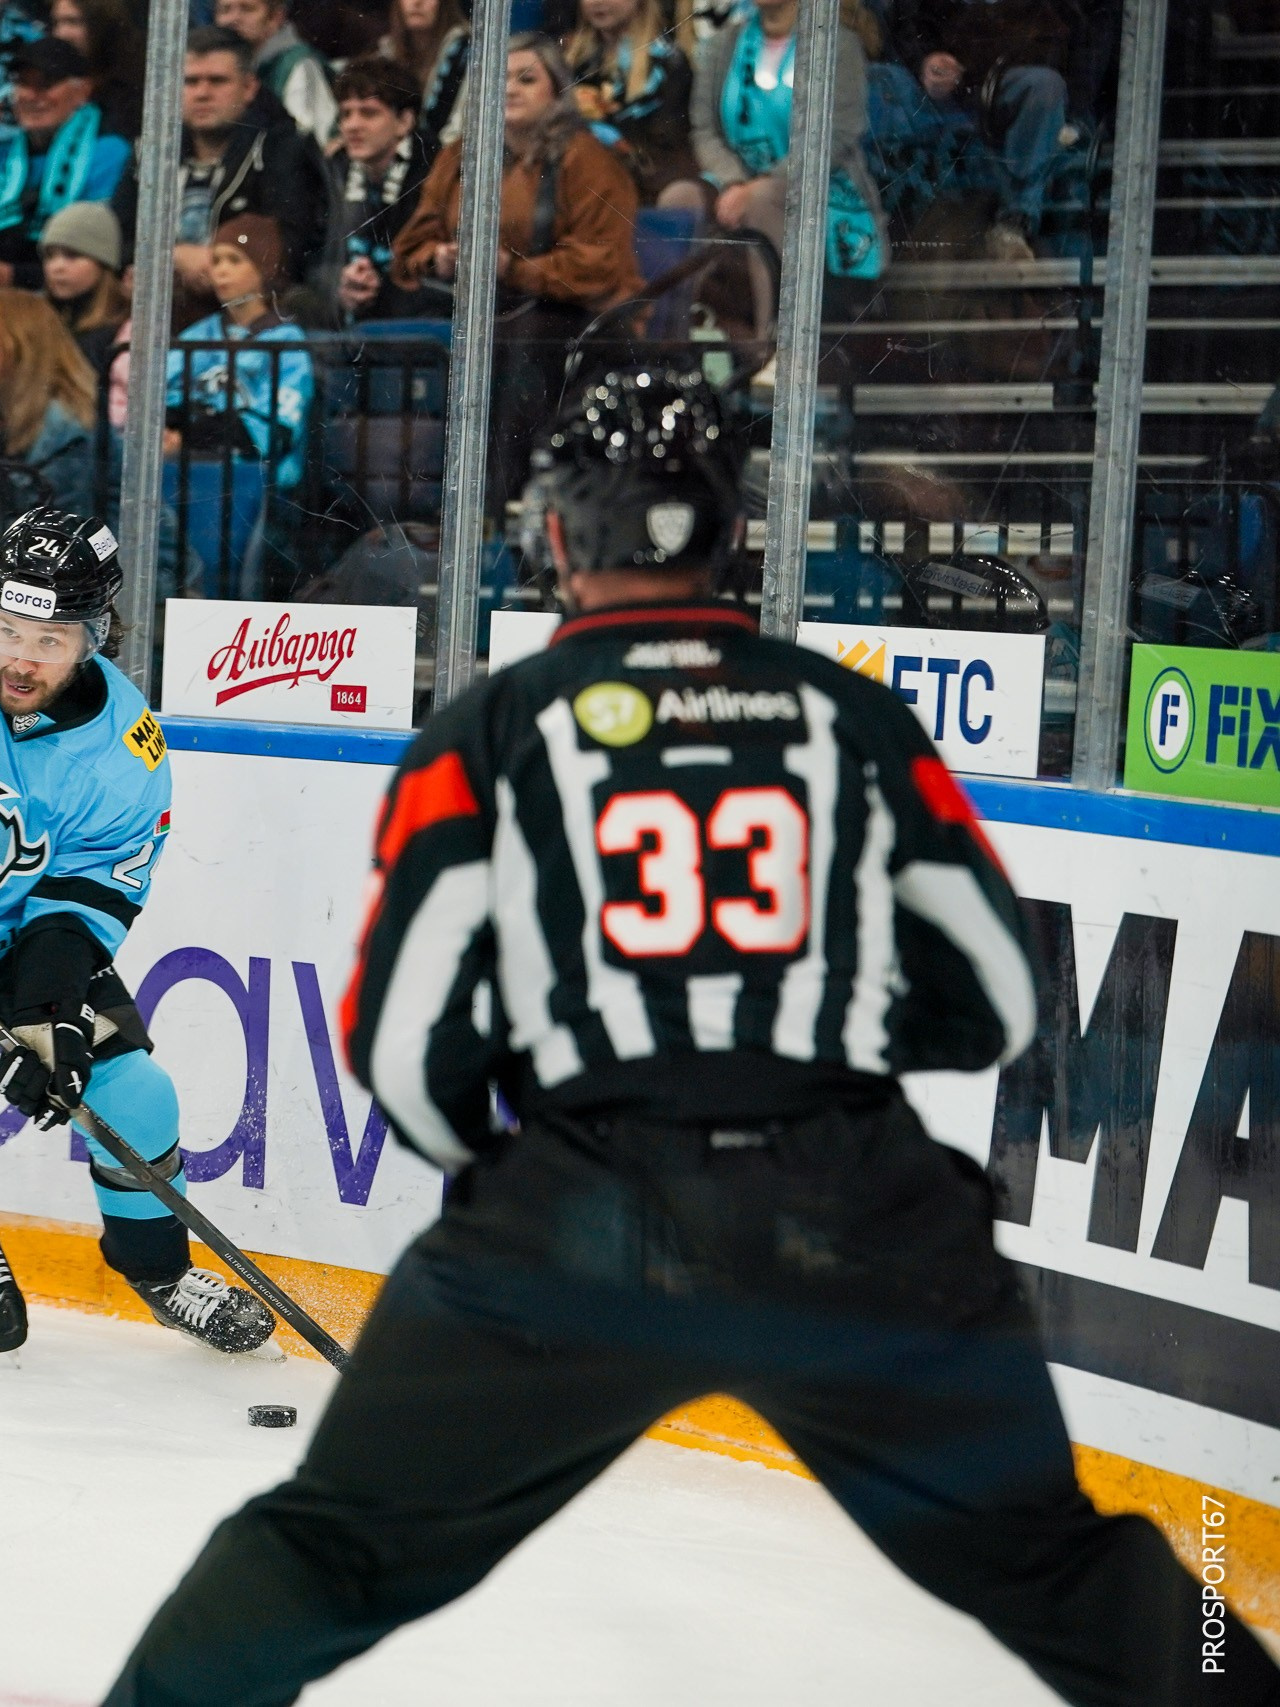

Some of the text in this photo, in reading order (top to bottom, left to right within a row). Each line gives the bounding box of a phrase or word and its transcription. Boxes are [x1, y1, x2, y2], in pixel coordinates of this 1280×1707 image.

[27, 535, 60, 558] 24
[4, 590, 52, 609] согаз
[336, 691, 362, 705] 1864
[656, 686, 801, 724] Airlines
[131, 712, 156, 749] MAX
[594, 785, 810, 958] 33
[223, 1252, 294, 1318] ULTRALOW KICKPOINT
